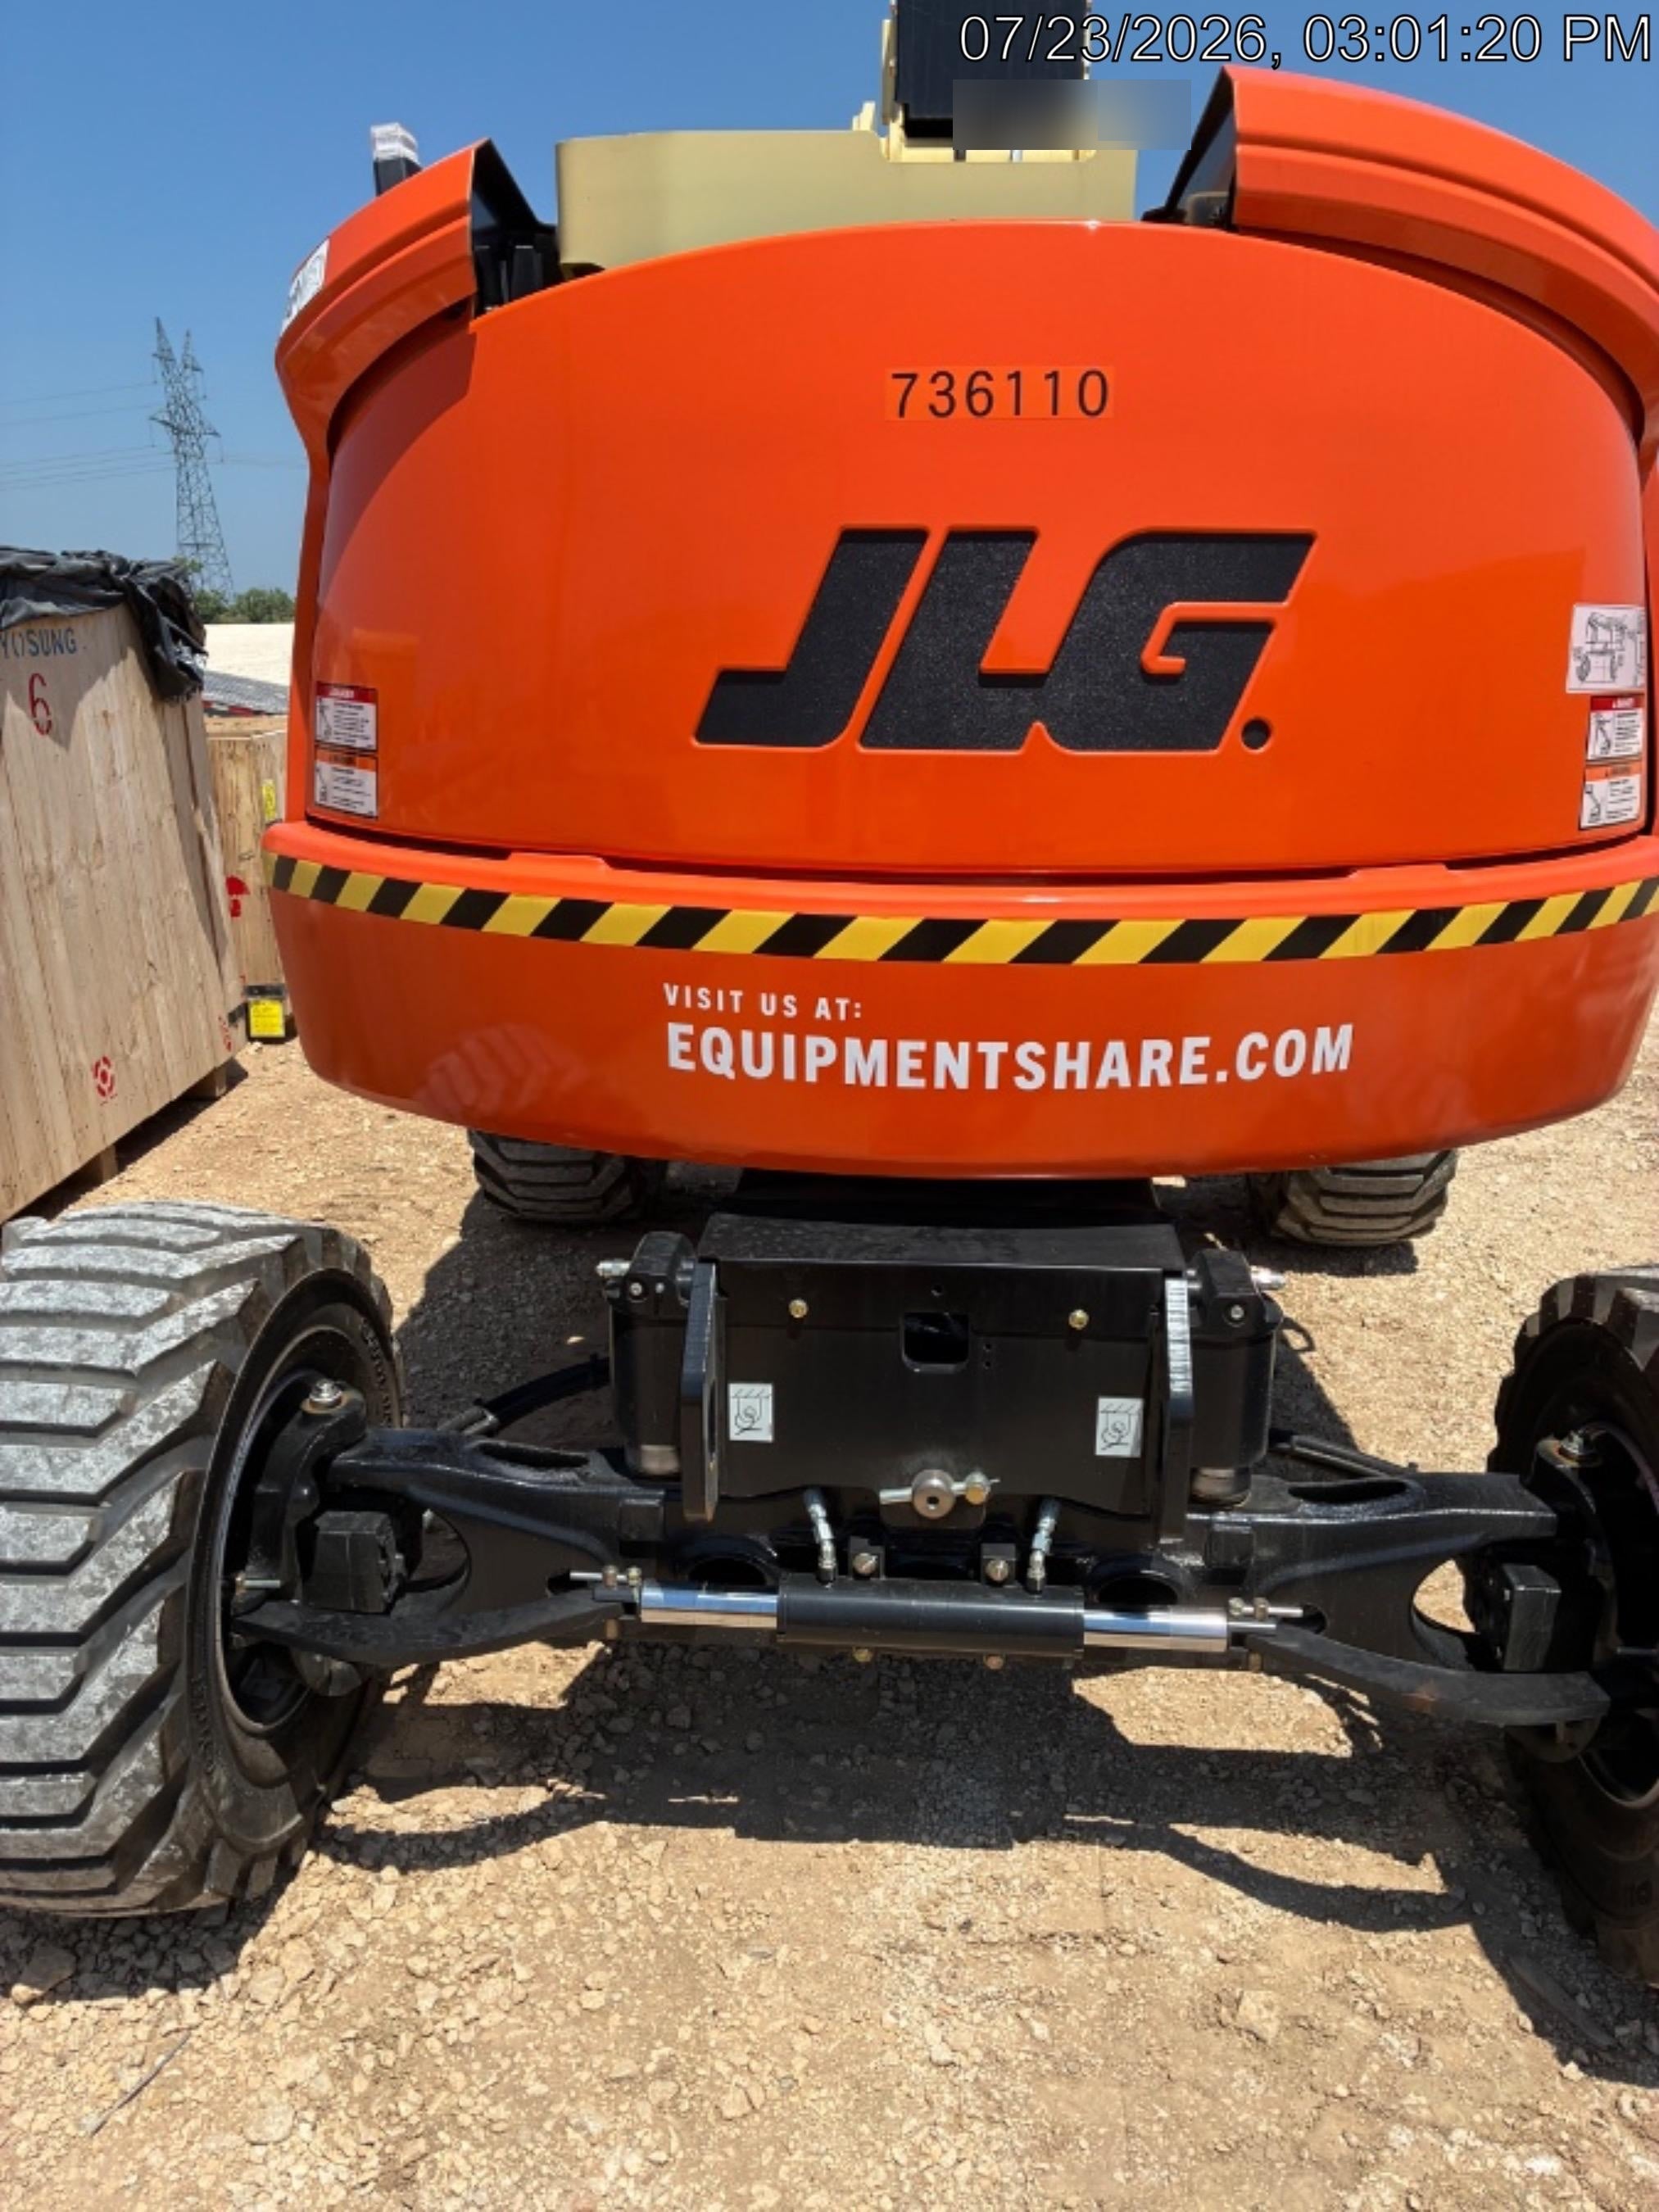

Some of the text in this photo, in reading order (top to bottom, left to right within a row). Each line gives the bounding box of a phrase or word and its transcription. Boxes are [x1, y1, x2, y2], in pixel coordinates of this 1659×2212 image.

[891, 369, 1108, 419] 736110
[29, 673, 52, 736] 6
[663, 982, 861, 1021] VISIT US AT:
[667, 1022, 1353, 1092] EQUIPMENTSHARE.COM
